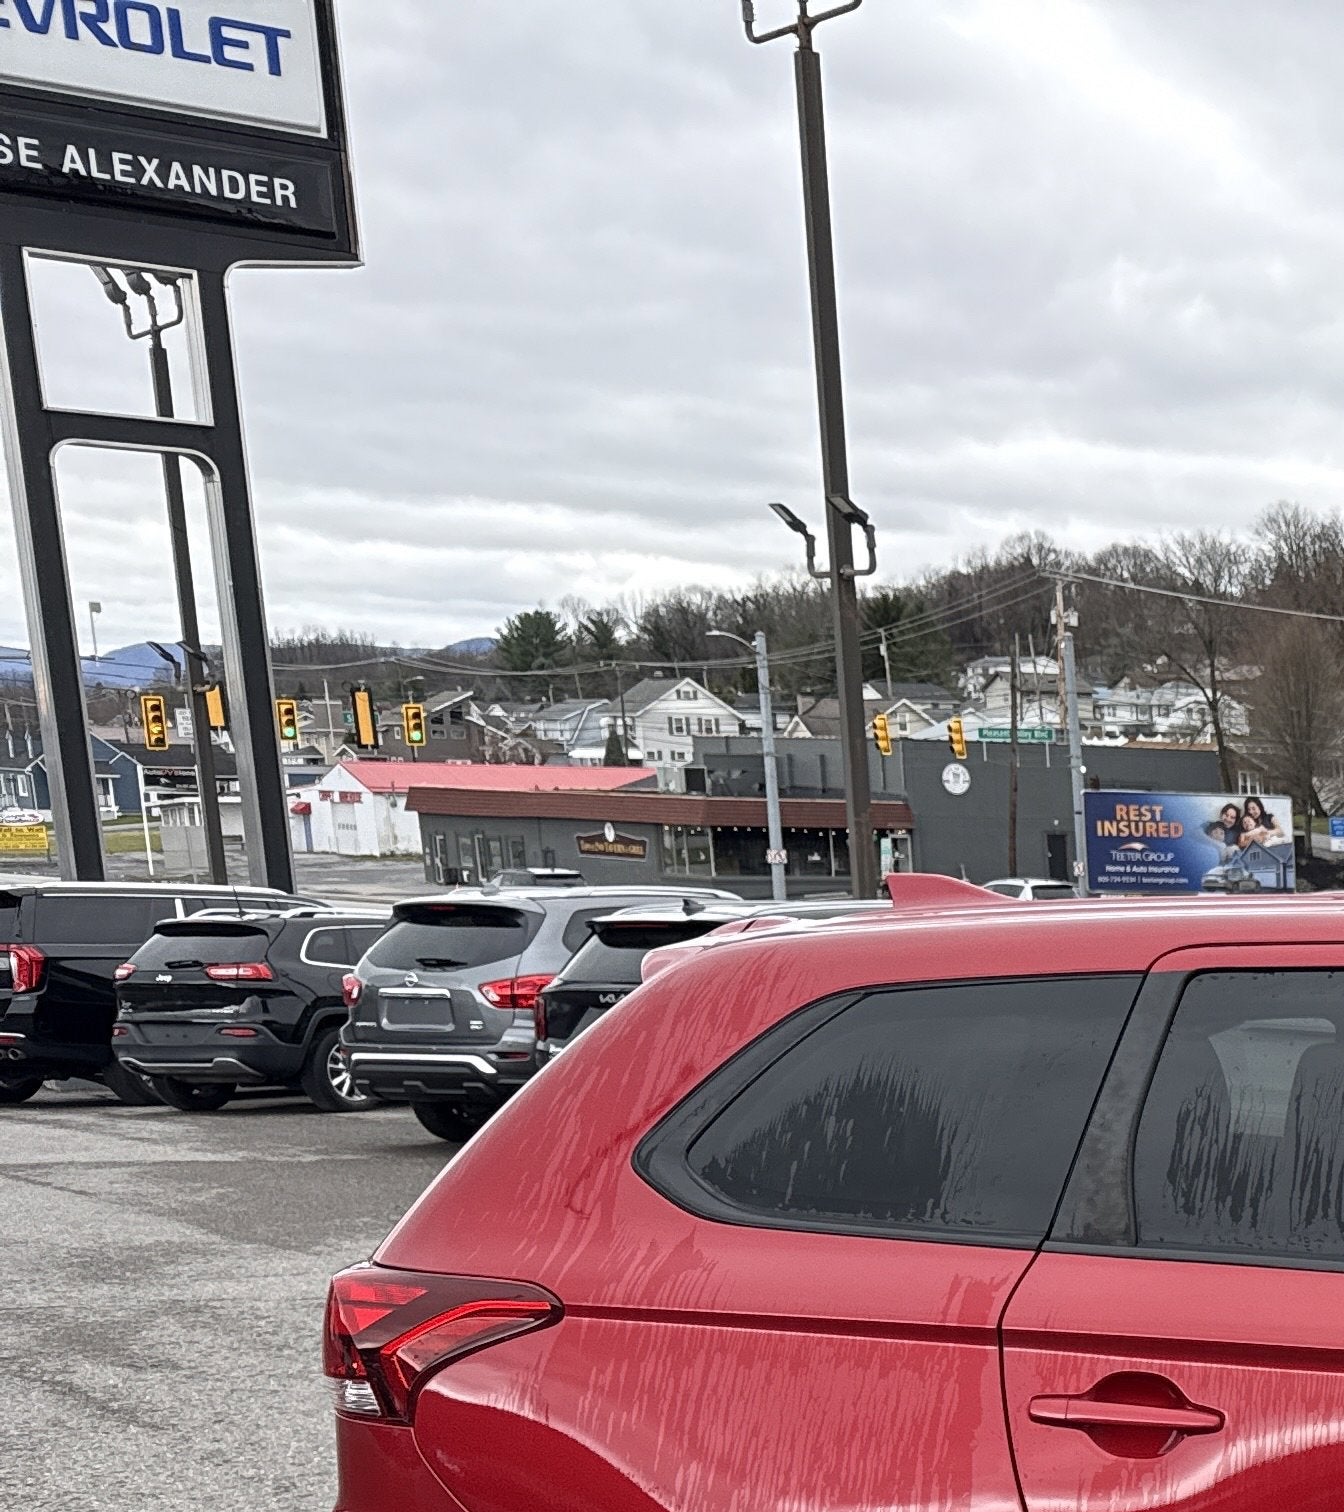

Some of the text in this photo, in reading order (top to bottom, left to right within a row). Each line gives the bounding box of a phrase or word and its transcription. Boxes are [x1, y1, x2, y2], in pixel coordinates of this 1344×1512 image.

[0, 0, 291, 77] VROLET
[61, 144, 297, 209] ALEXANDER
[1115, 804, 1163, 821] REST
[1096, 820, 1184, 838] INSURED
[1105, 865, 1125, 873] Home
[1132, 865, 1147, 873] Auto
[1148, 866, 1180, 874] Insurance
[155, 974, 173, 983] Jeep
